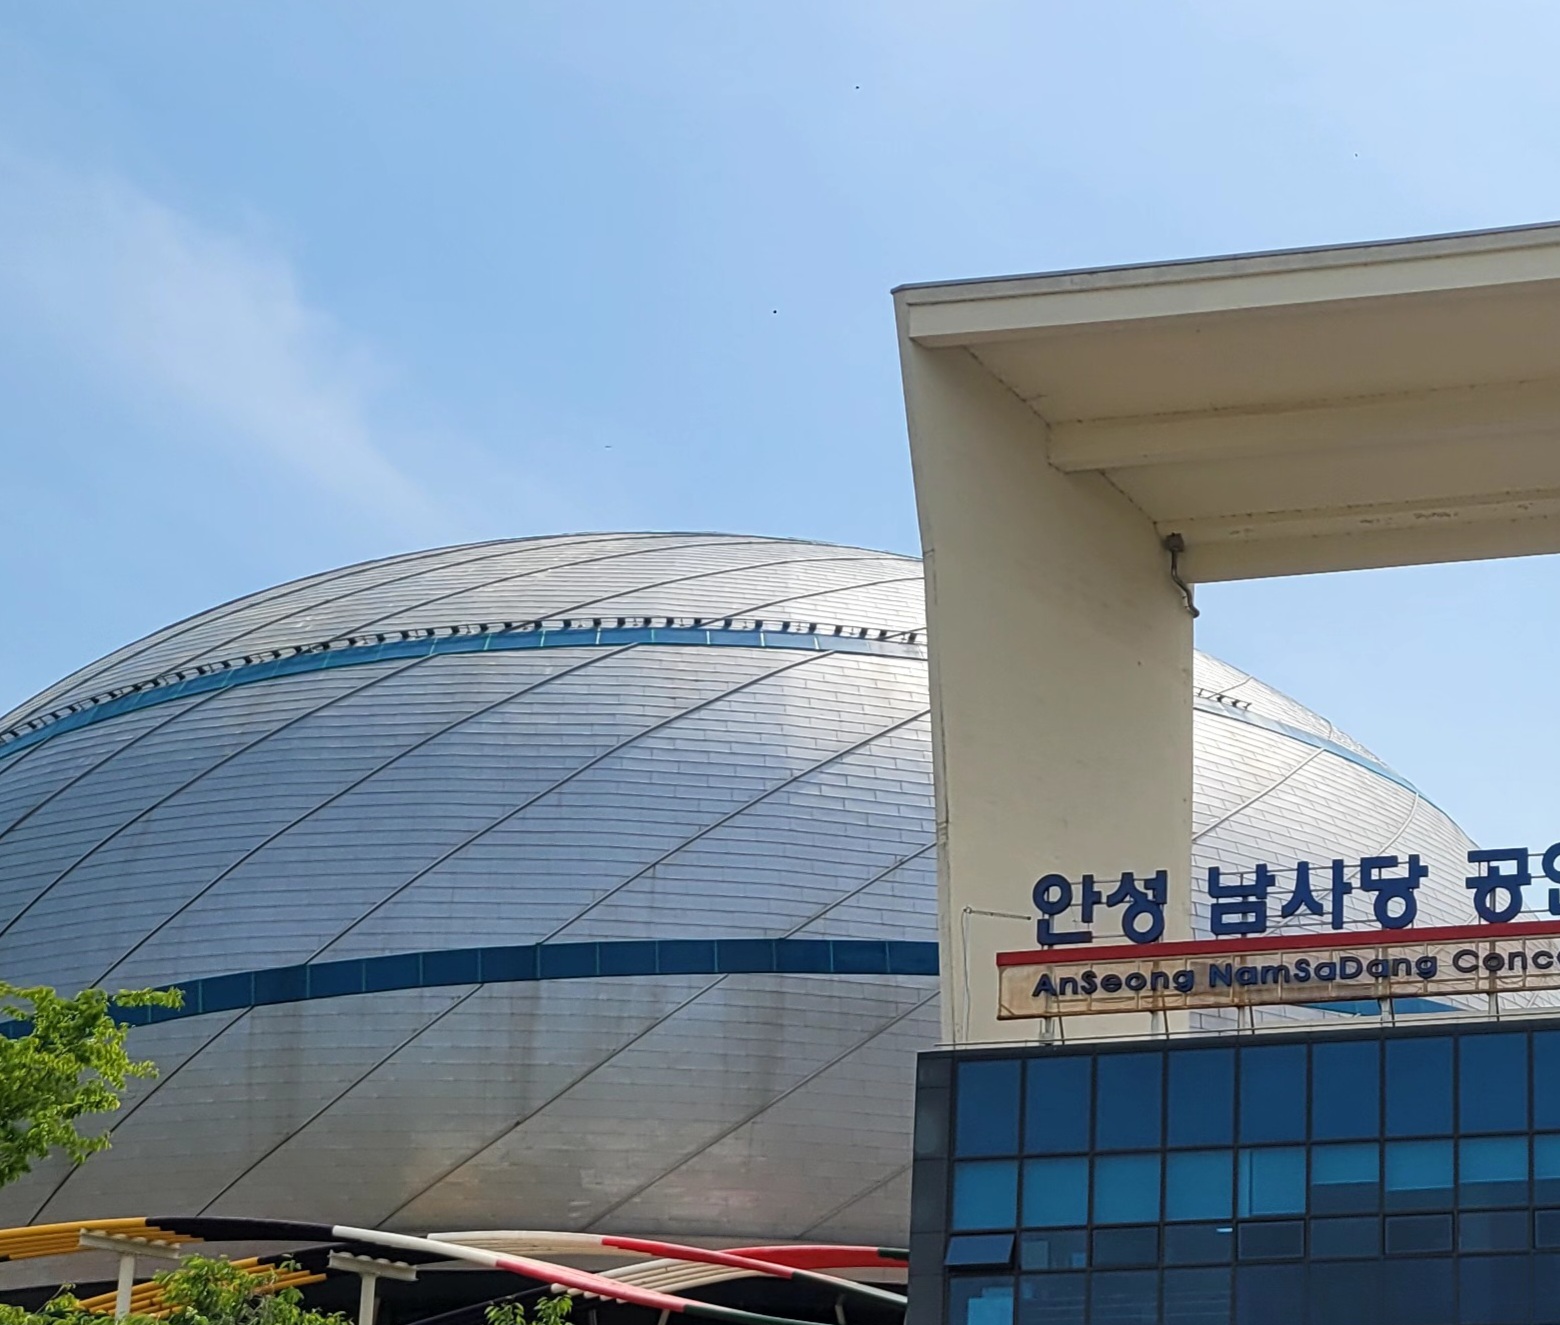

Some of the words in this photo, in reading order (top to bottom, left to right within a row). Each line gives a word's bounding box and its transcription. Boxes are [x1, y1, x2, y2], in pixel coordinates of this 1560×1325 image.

[1033, 869, 1168, 945] 안성
[1208, 854, 1429, 935] 남사당
[1032, 969, 1195, 998] AnSeong
[1208, 955, 1438, 987] NamSaDang
